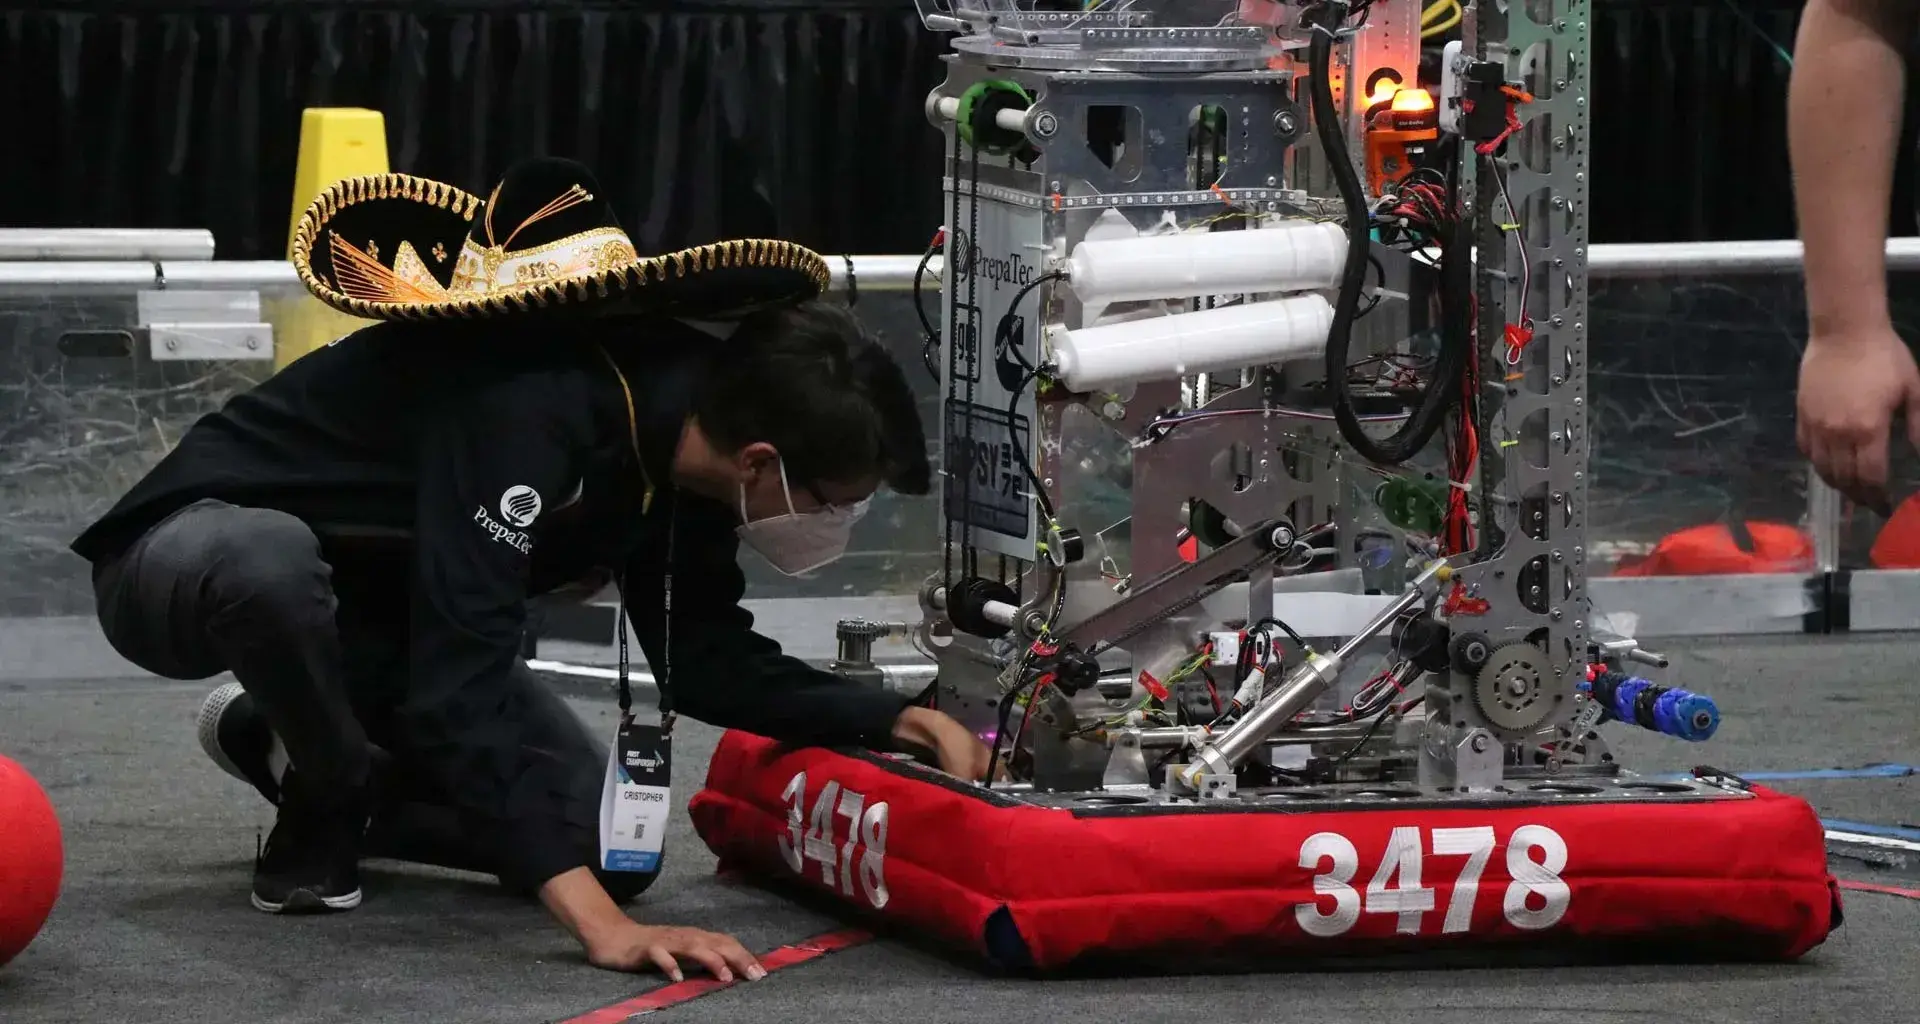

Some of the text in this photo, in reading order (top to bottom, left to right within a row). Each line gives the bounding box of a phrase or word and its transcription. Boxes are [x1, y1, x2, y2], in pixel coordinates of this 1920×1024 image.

[973, 246, 1034, 291] PrepaTec
[474, 505, 533, 555] PrepaTec
[624, 790, 664, 802] CRISTOPHER
[777, 771, 889, 909] 3478
[1295, 824, 1571, 937] 3478
